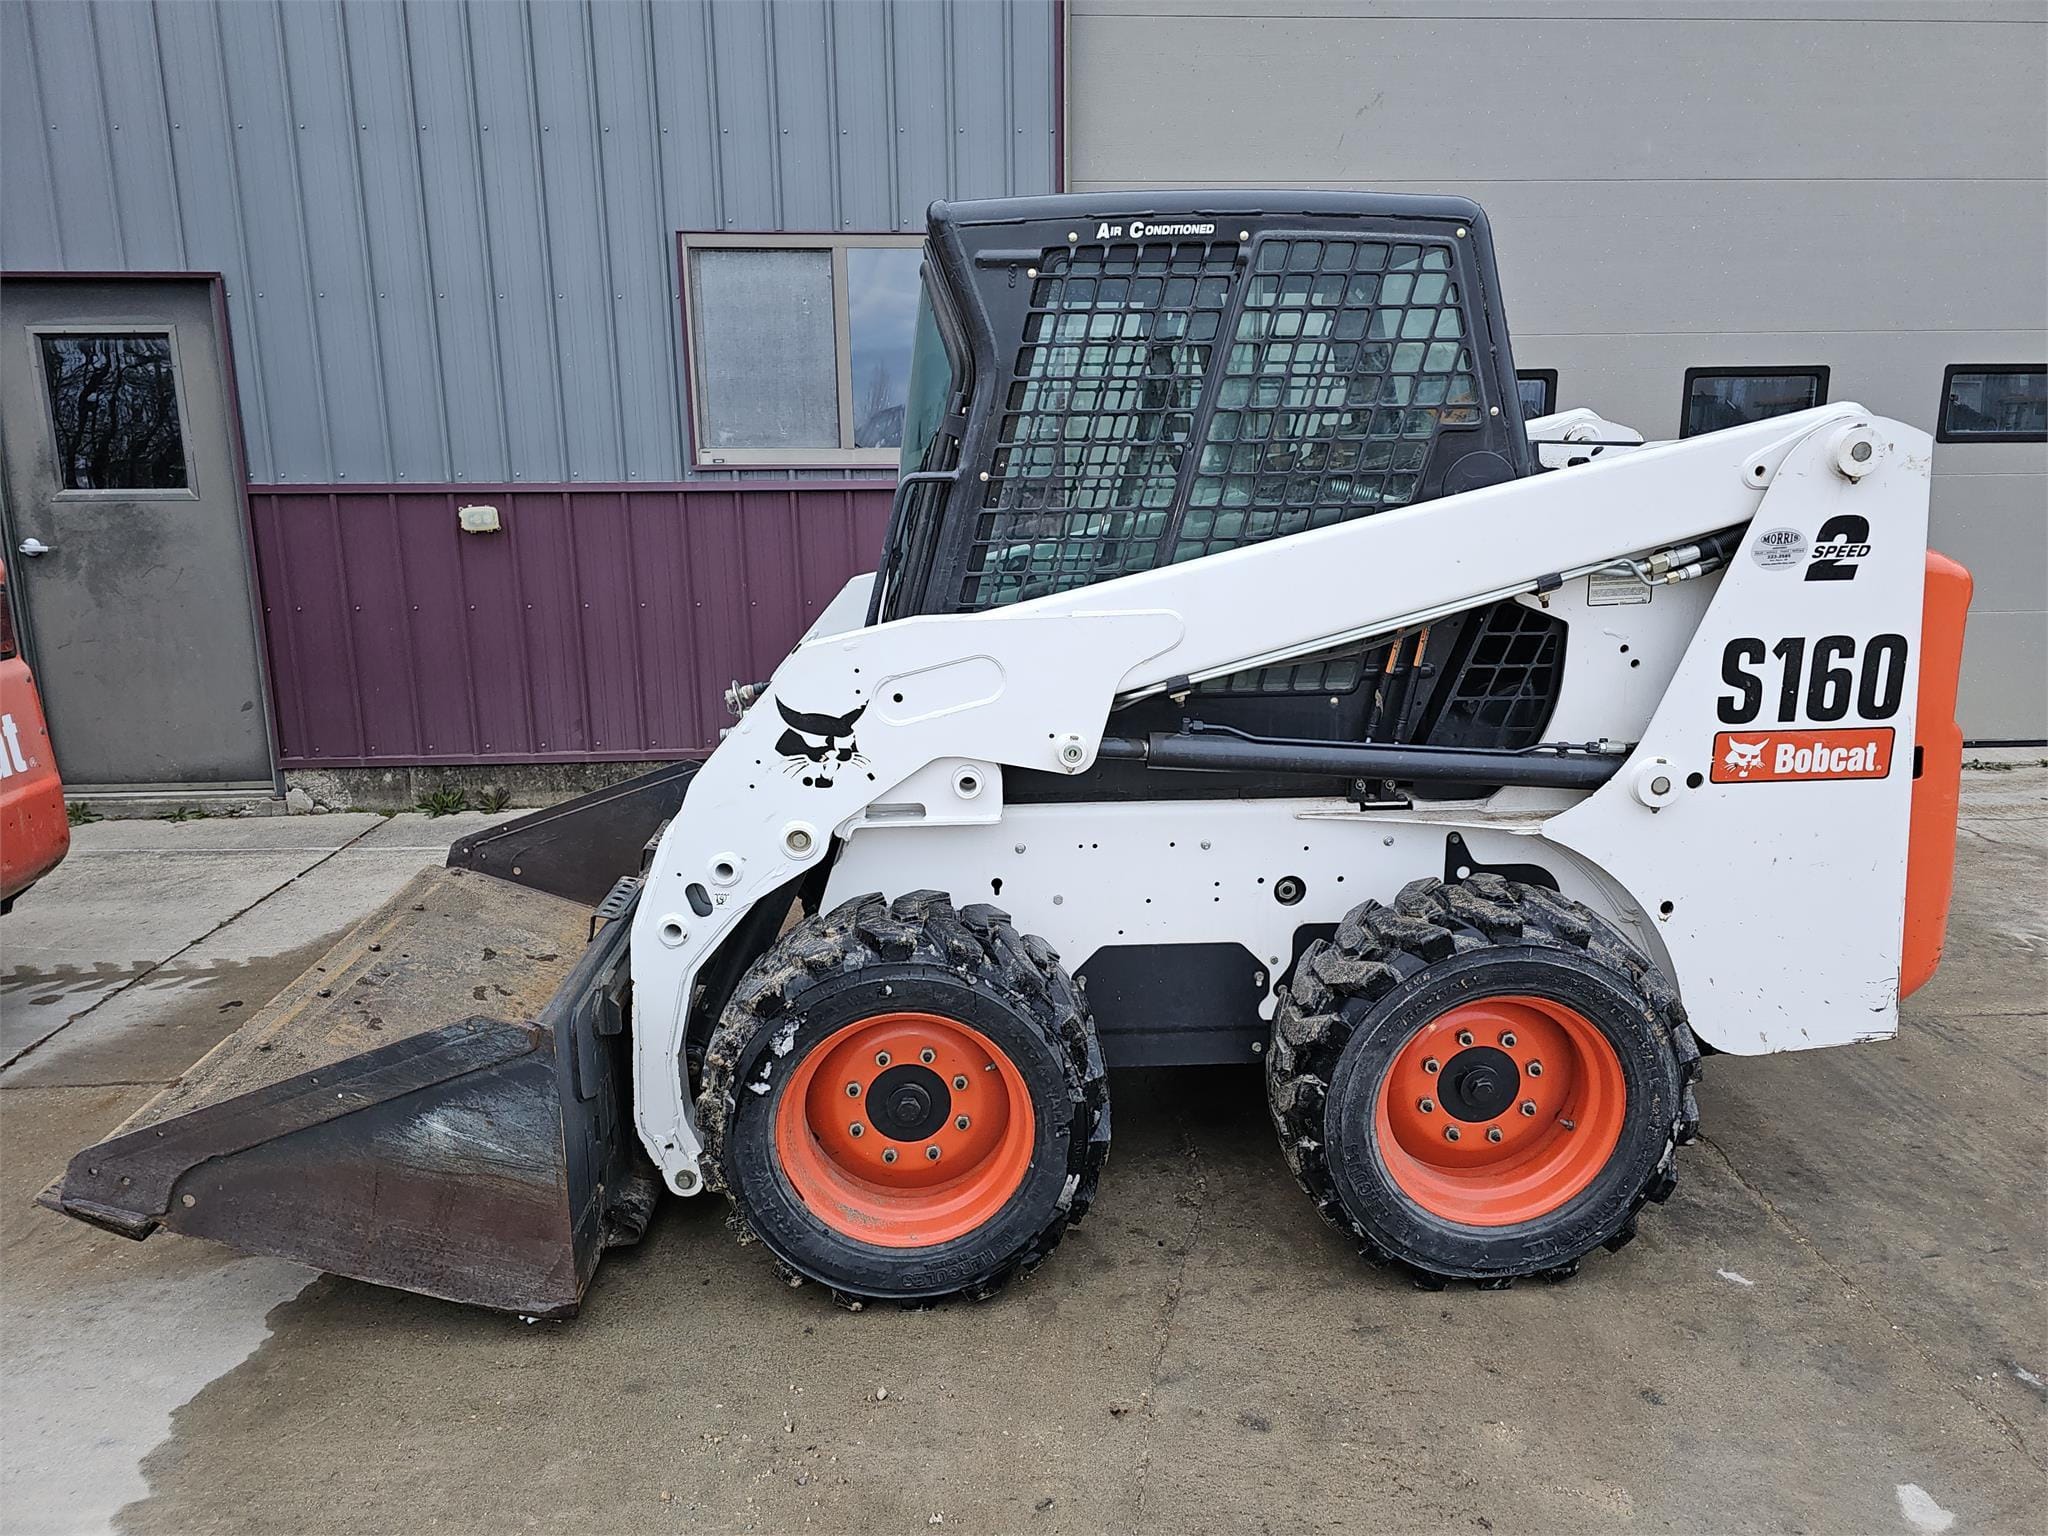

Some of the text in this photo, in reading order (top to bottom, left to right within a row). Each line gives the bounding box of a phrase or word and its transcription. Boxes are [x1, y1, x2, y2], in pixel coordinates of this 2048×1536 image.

[1762, 532, 1799, 545] MORRIS
[1804, 514, 1870, 582] 2
[1811, 545, 1871, 559] SPEED
[1717, 633, 1909, 725] S160
[1773, 742, 1878, 775] Bobcat
[902, 1248, 997, 1288] HERCULES
